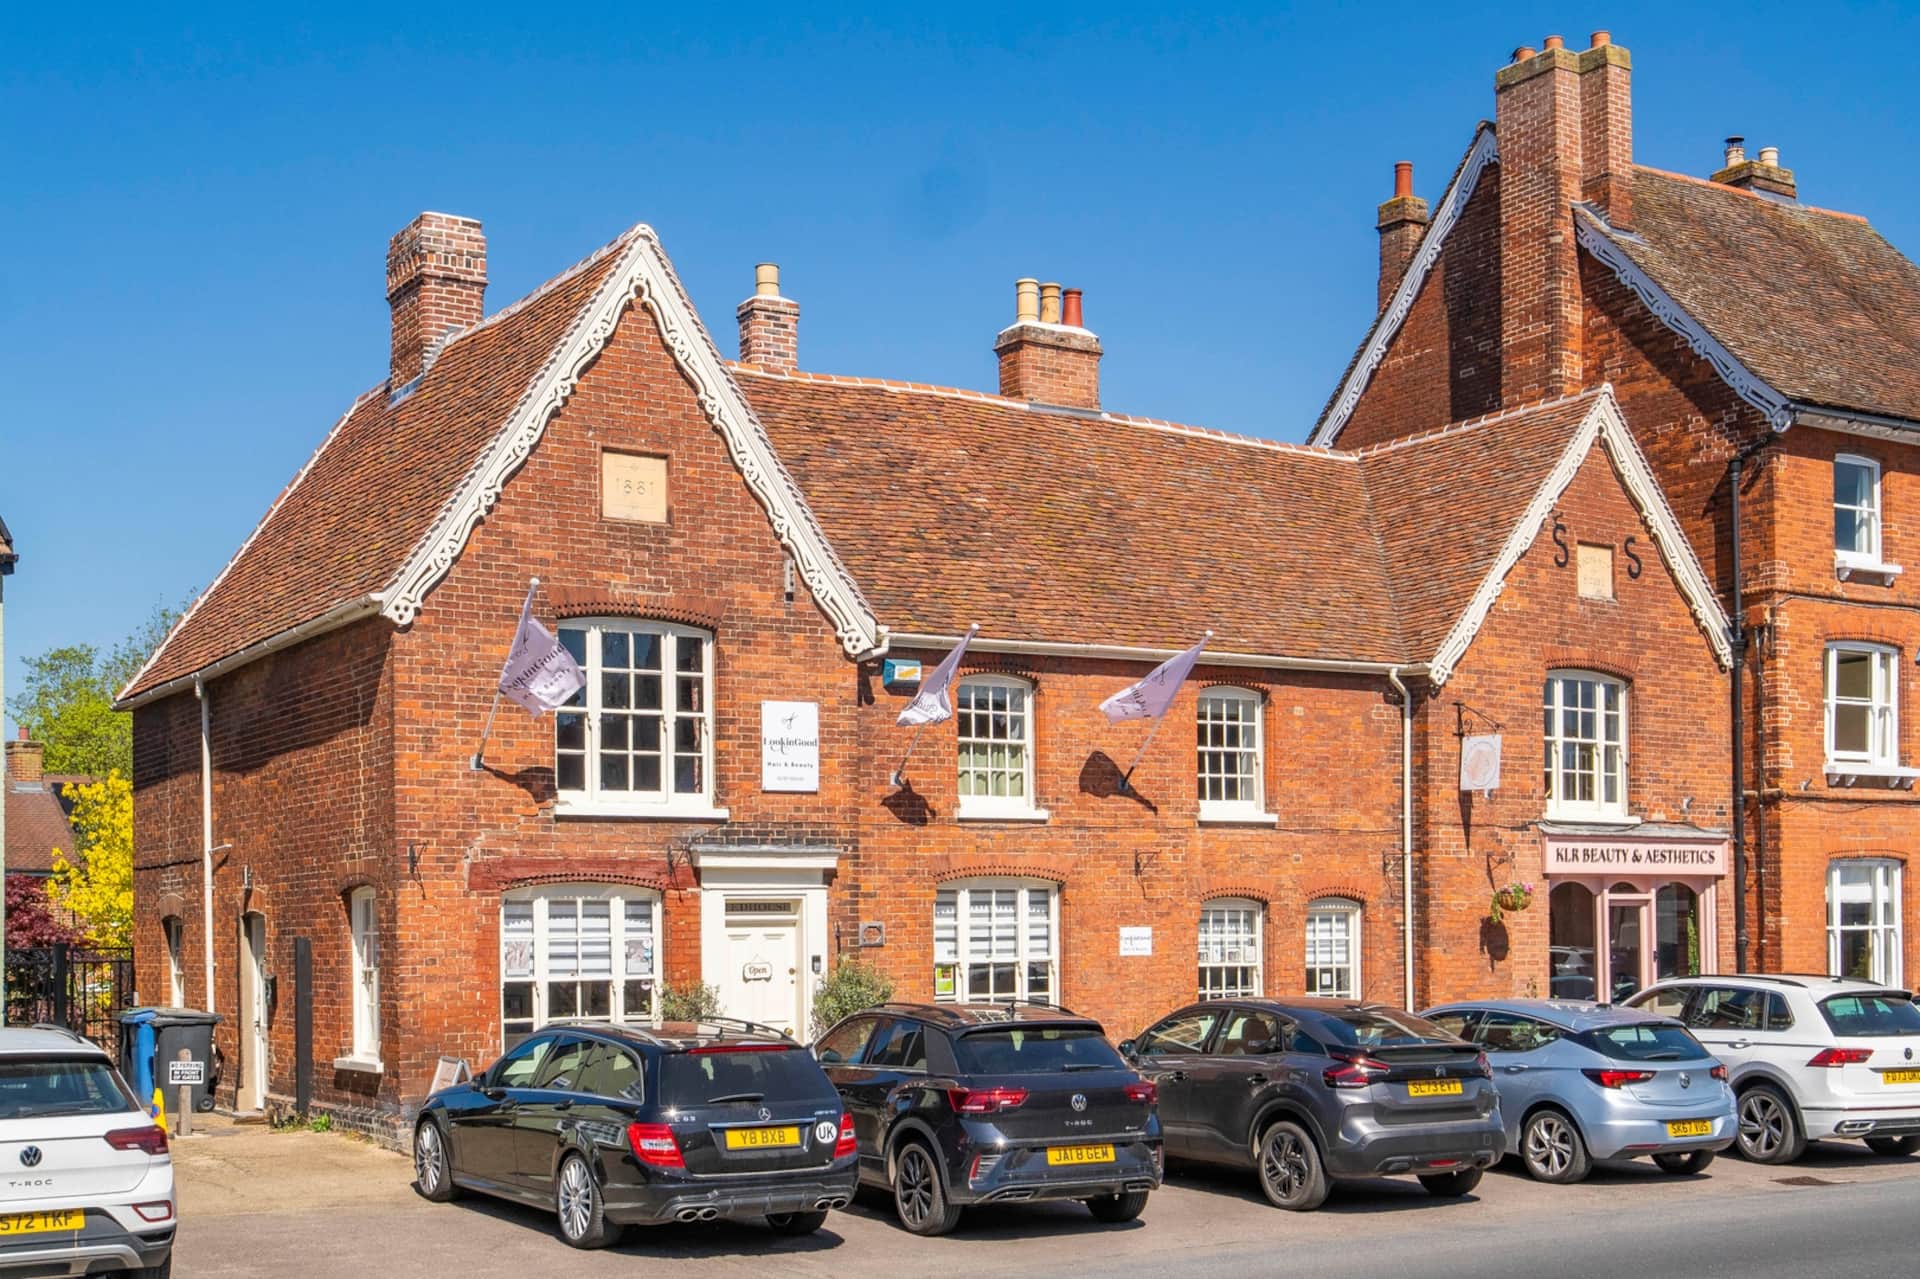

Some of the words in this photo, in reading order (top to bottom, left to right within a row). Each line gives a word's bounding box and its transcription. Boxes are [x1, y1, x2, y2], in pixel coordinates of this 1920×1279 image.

[1556, 847, 1580, 863] KLR
[1582, 848, 1630, 864] BEAUTY
[1631, 849, 1643, 864] &
[1644, 849, 1716, 865] AESTHETICS
[748, 966, 768, 977] Open
[761, 1129, 786, 1144] BXB
[817, 1126, 836, 1139] UK
[9, 1178, 53, 1188] T-ROC
[38, 1210, 74, 1229] TKF
